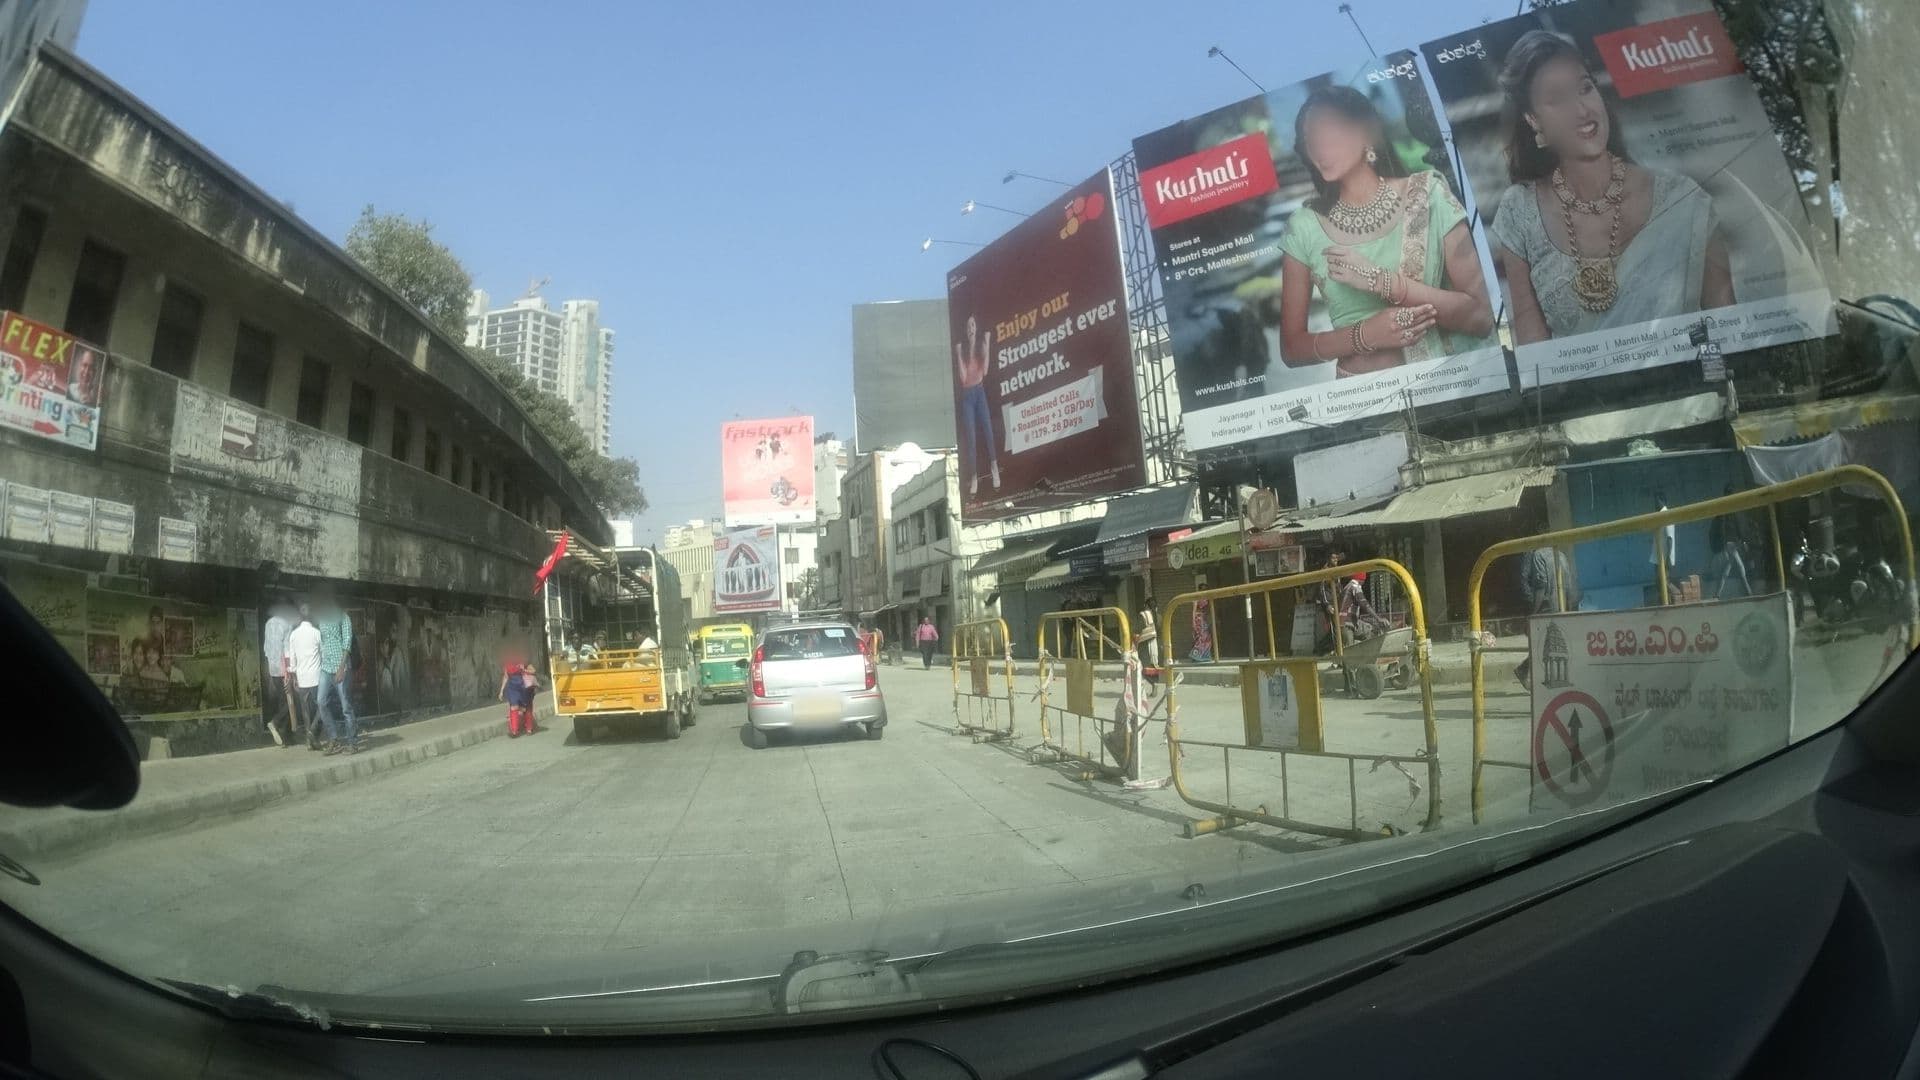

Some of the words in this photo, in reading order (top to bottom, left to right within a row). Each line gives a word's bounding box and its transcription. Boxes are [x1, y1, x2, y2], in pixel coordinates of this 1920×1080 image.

[1622, 26, 1714, 71] Kushal's
[1155, 151, 1248, 204] Kushal's
[1190, 188, 1216, 203] fashion
[1217, 179, 1250, 197] jewellery
[1169, 239, 1192, 252] Stores
[1193, 236, 1201, 246] at
[1172, 251, 1201, 266] Mantri
[1201, 241, 1235, 258] Square
[1235, 233, 1255, 247] Mall
[1207, 245, 1274, 271] Malleshwaram
[996, 308, 1038, 342] Enjoy
[1042, 291, 1070, 318] our
[4, 319, 73, 364] FLEX
[998, 316, 1074, 369] Strongest
[1077, 299, 1117, 330] ever
[1558, 343, 1600, 359] Jayanagar
[1614, 335, 1641, 348] Mantri
[1641, 331, 1658, 343] Mall
[1700, 343, 1720, 355] P.G.
[1000, 352, 1071, 396] network.
[1551, 360, 1598, 375] Indiranagar
[1613, 353, 1631, 365] HSR
[1195, 374, 1267, 397] www.kushals.com
[1218, 409, 1256, 424] Jayanagar
[1270, 400, 1295, 412] Mantri
[1296, 396, 1313, 407] Mall
[1326, 384, 1375, 400] Commercial
[1375, 378, 1401, 391] Street
[1415, 364, 1470, 382] Koramangala
[1017, 413, 1050, 433] Roaming
[1064, 397, 1096, 415] GB/Day
[1021, 396, 1058, 419] Unlimited
[1059, 389, 1080, 404] Calls
[1211, 424, 1253, 439] Indiranagar
[1267, 417, 1285, 427] HSR
[1326, 397, 1384, 415] Malleshwaram
[1052, 422, 1062, 433] 28
[1063, 415, 1084, 430] Days
[1220, 546, 1232, 556] 4G
